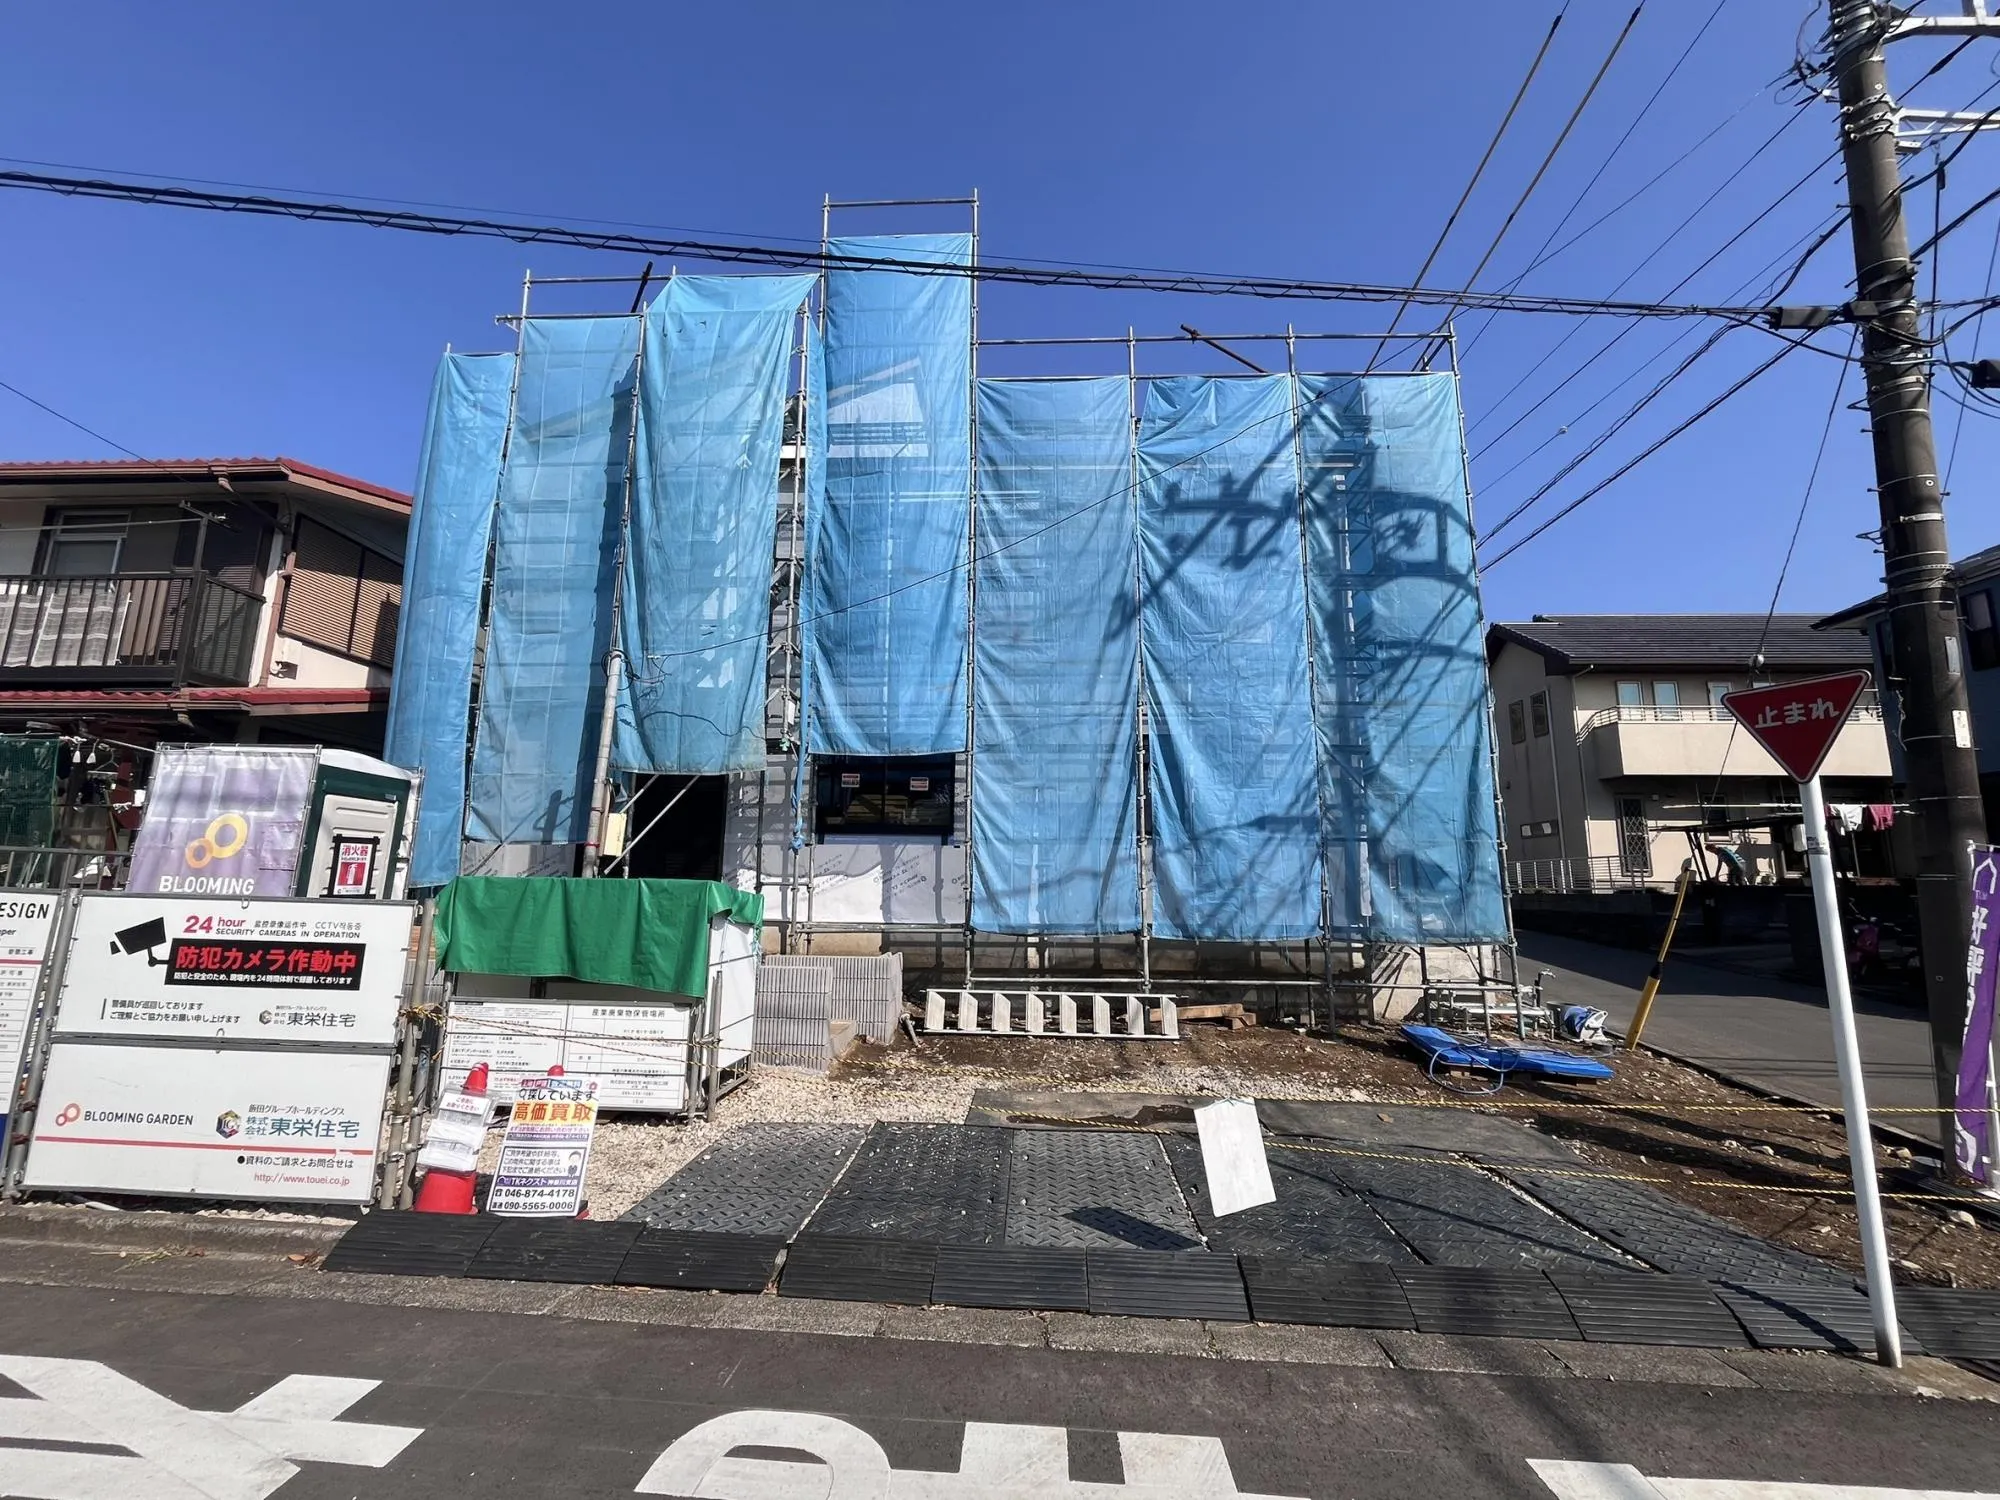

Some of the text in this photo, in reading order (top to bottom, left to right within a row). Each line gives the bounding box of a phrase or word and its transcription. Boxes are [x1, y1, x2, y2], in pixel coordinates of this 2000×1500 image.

[1755, 698, 1840, 728] 止まれ
[158, 875, 255, 895] BLOOMING
[183, 915, 246, 934] 24 hour
[216, 928, 255, 936] SECURITY
[259, 929, 297, 937] CAMERAS
[313, 931, 361, 939] OPERATION
[175, 946, 357, 973] 防犯カメラ作動中
[110, 1011, 240, 1024] ご理解とご協力をお願い申し上げます
[286, 1012, 357, 1028] 東栄住宅
[248, 1103, 345, 1116] 飯田グループホールディングス
[513, 1102, 592, 1121] 高価買取
[84, 1110, 194, 1126] BLOOMING GARDEN
[268, 1117, 360, 1139] 東栄住宅
[246, 1155, 354, 1169] 資料のご請求とお問合せは
[254, 1173, 351, 1187] http://www.touei.co.jp
[504, 1188, 575, 1198] 046-874-4178
[504, 1201, 573, 1210] 090-5565-0006
